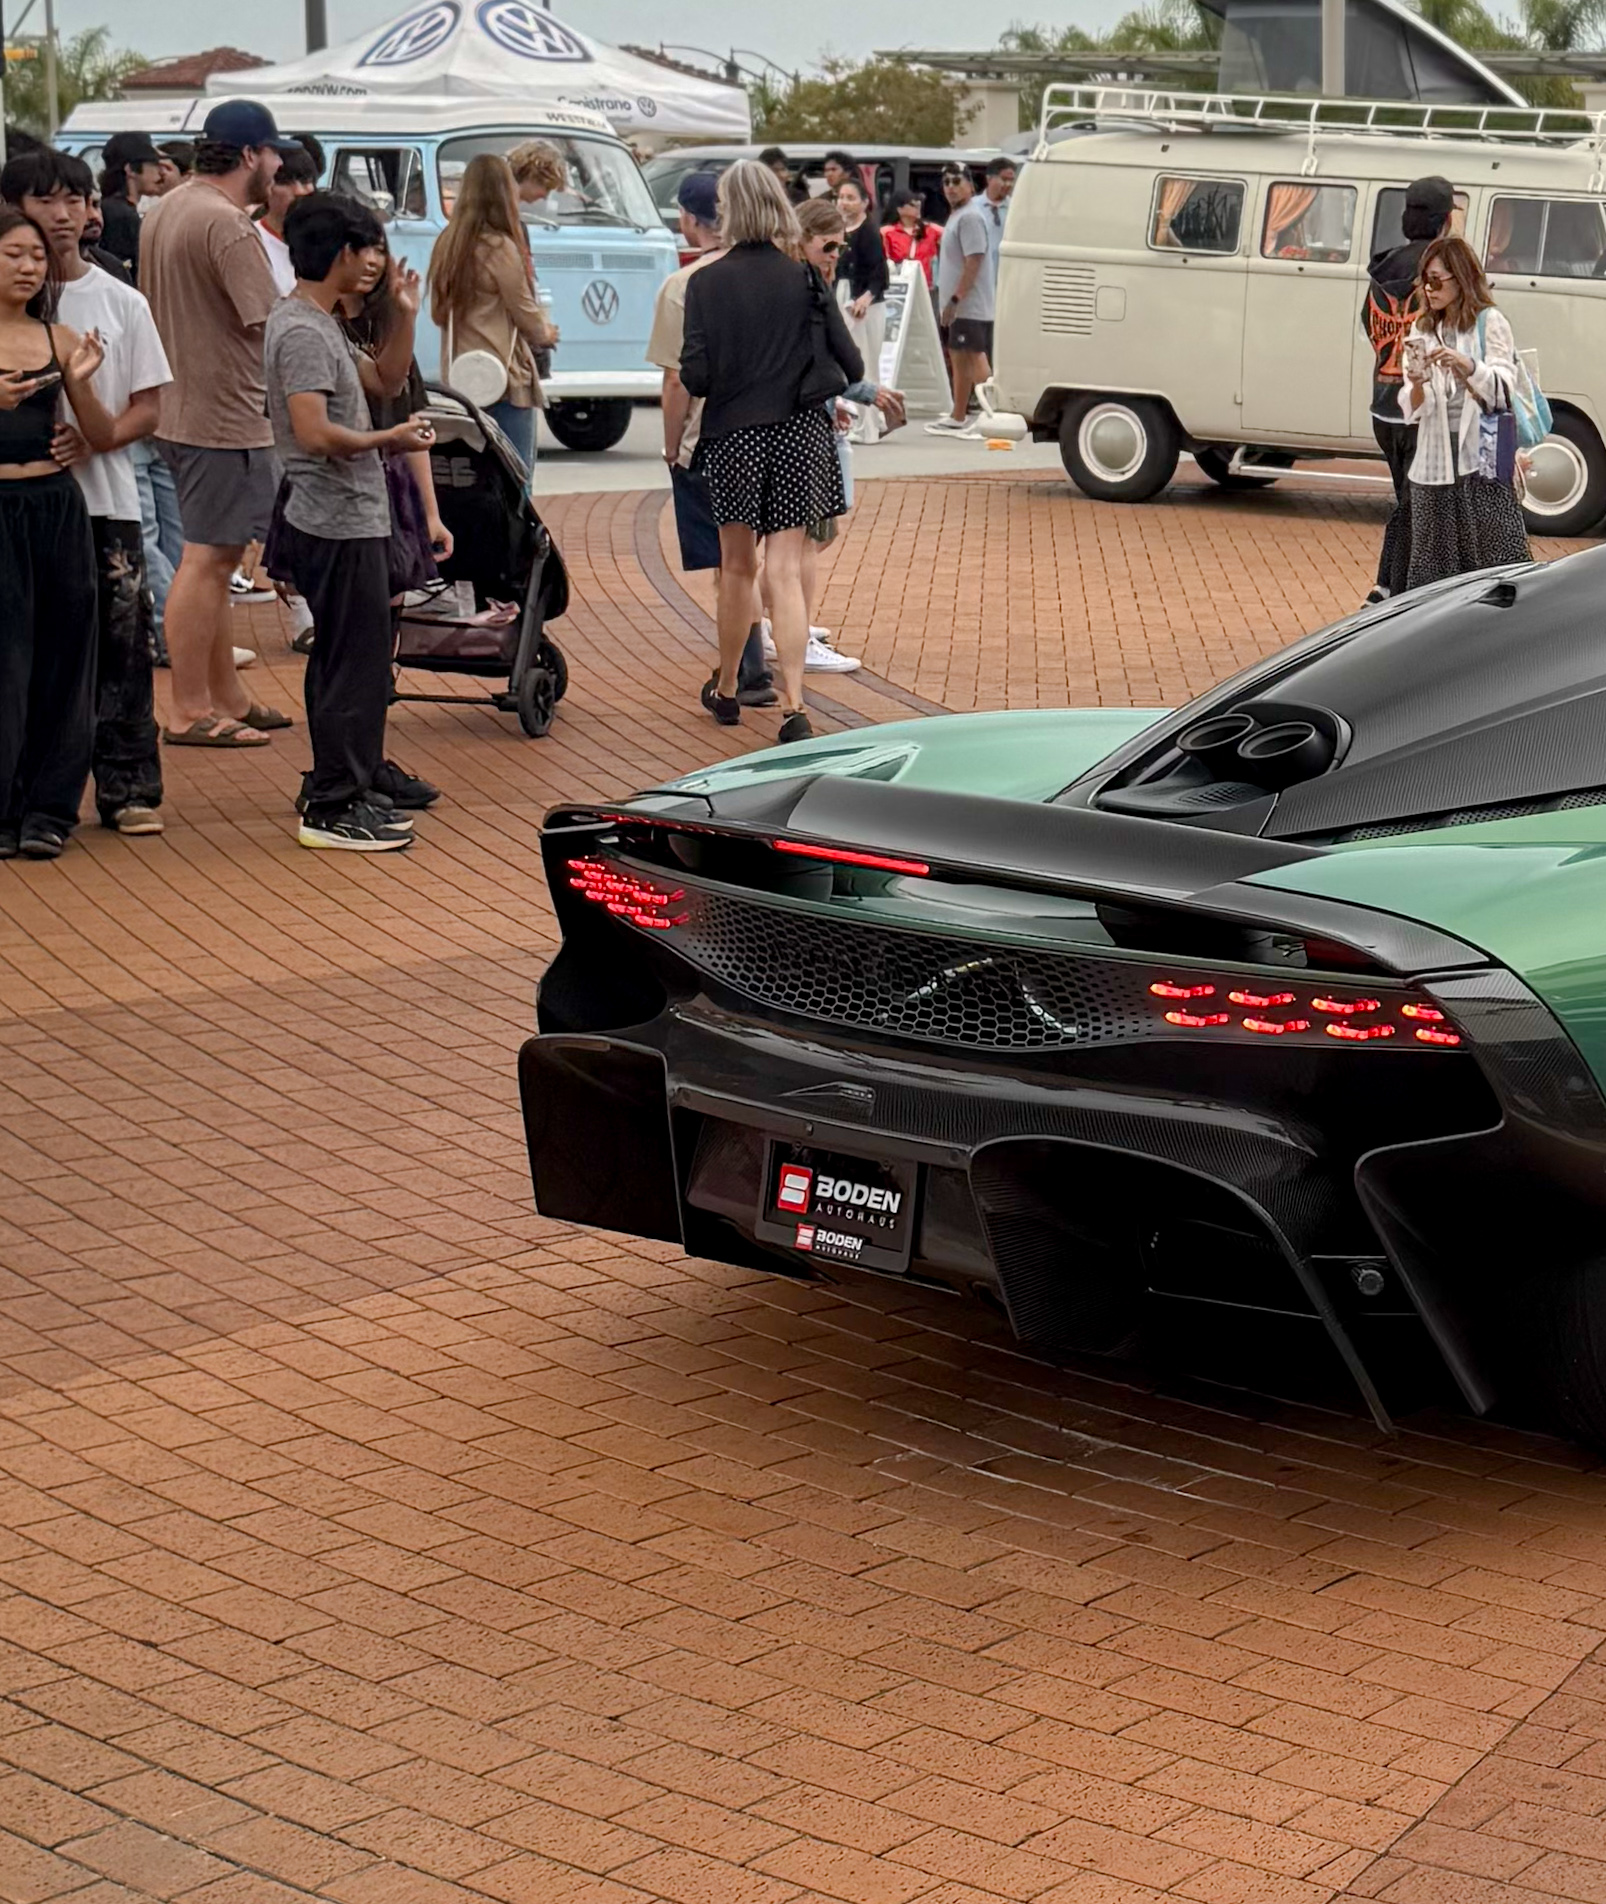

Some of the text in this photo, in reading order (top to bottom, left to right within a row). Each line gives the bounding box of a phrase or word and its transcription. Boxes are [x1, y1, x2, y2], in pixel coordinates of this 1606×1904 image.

[557, 95, 632, 111] istrano
[816, 1176, 901, 1213] BODEN
[815, 1203, 895, 1229] AUTOHAUS
[816, 1229, 863, 1250] BODEN
